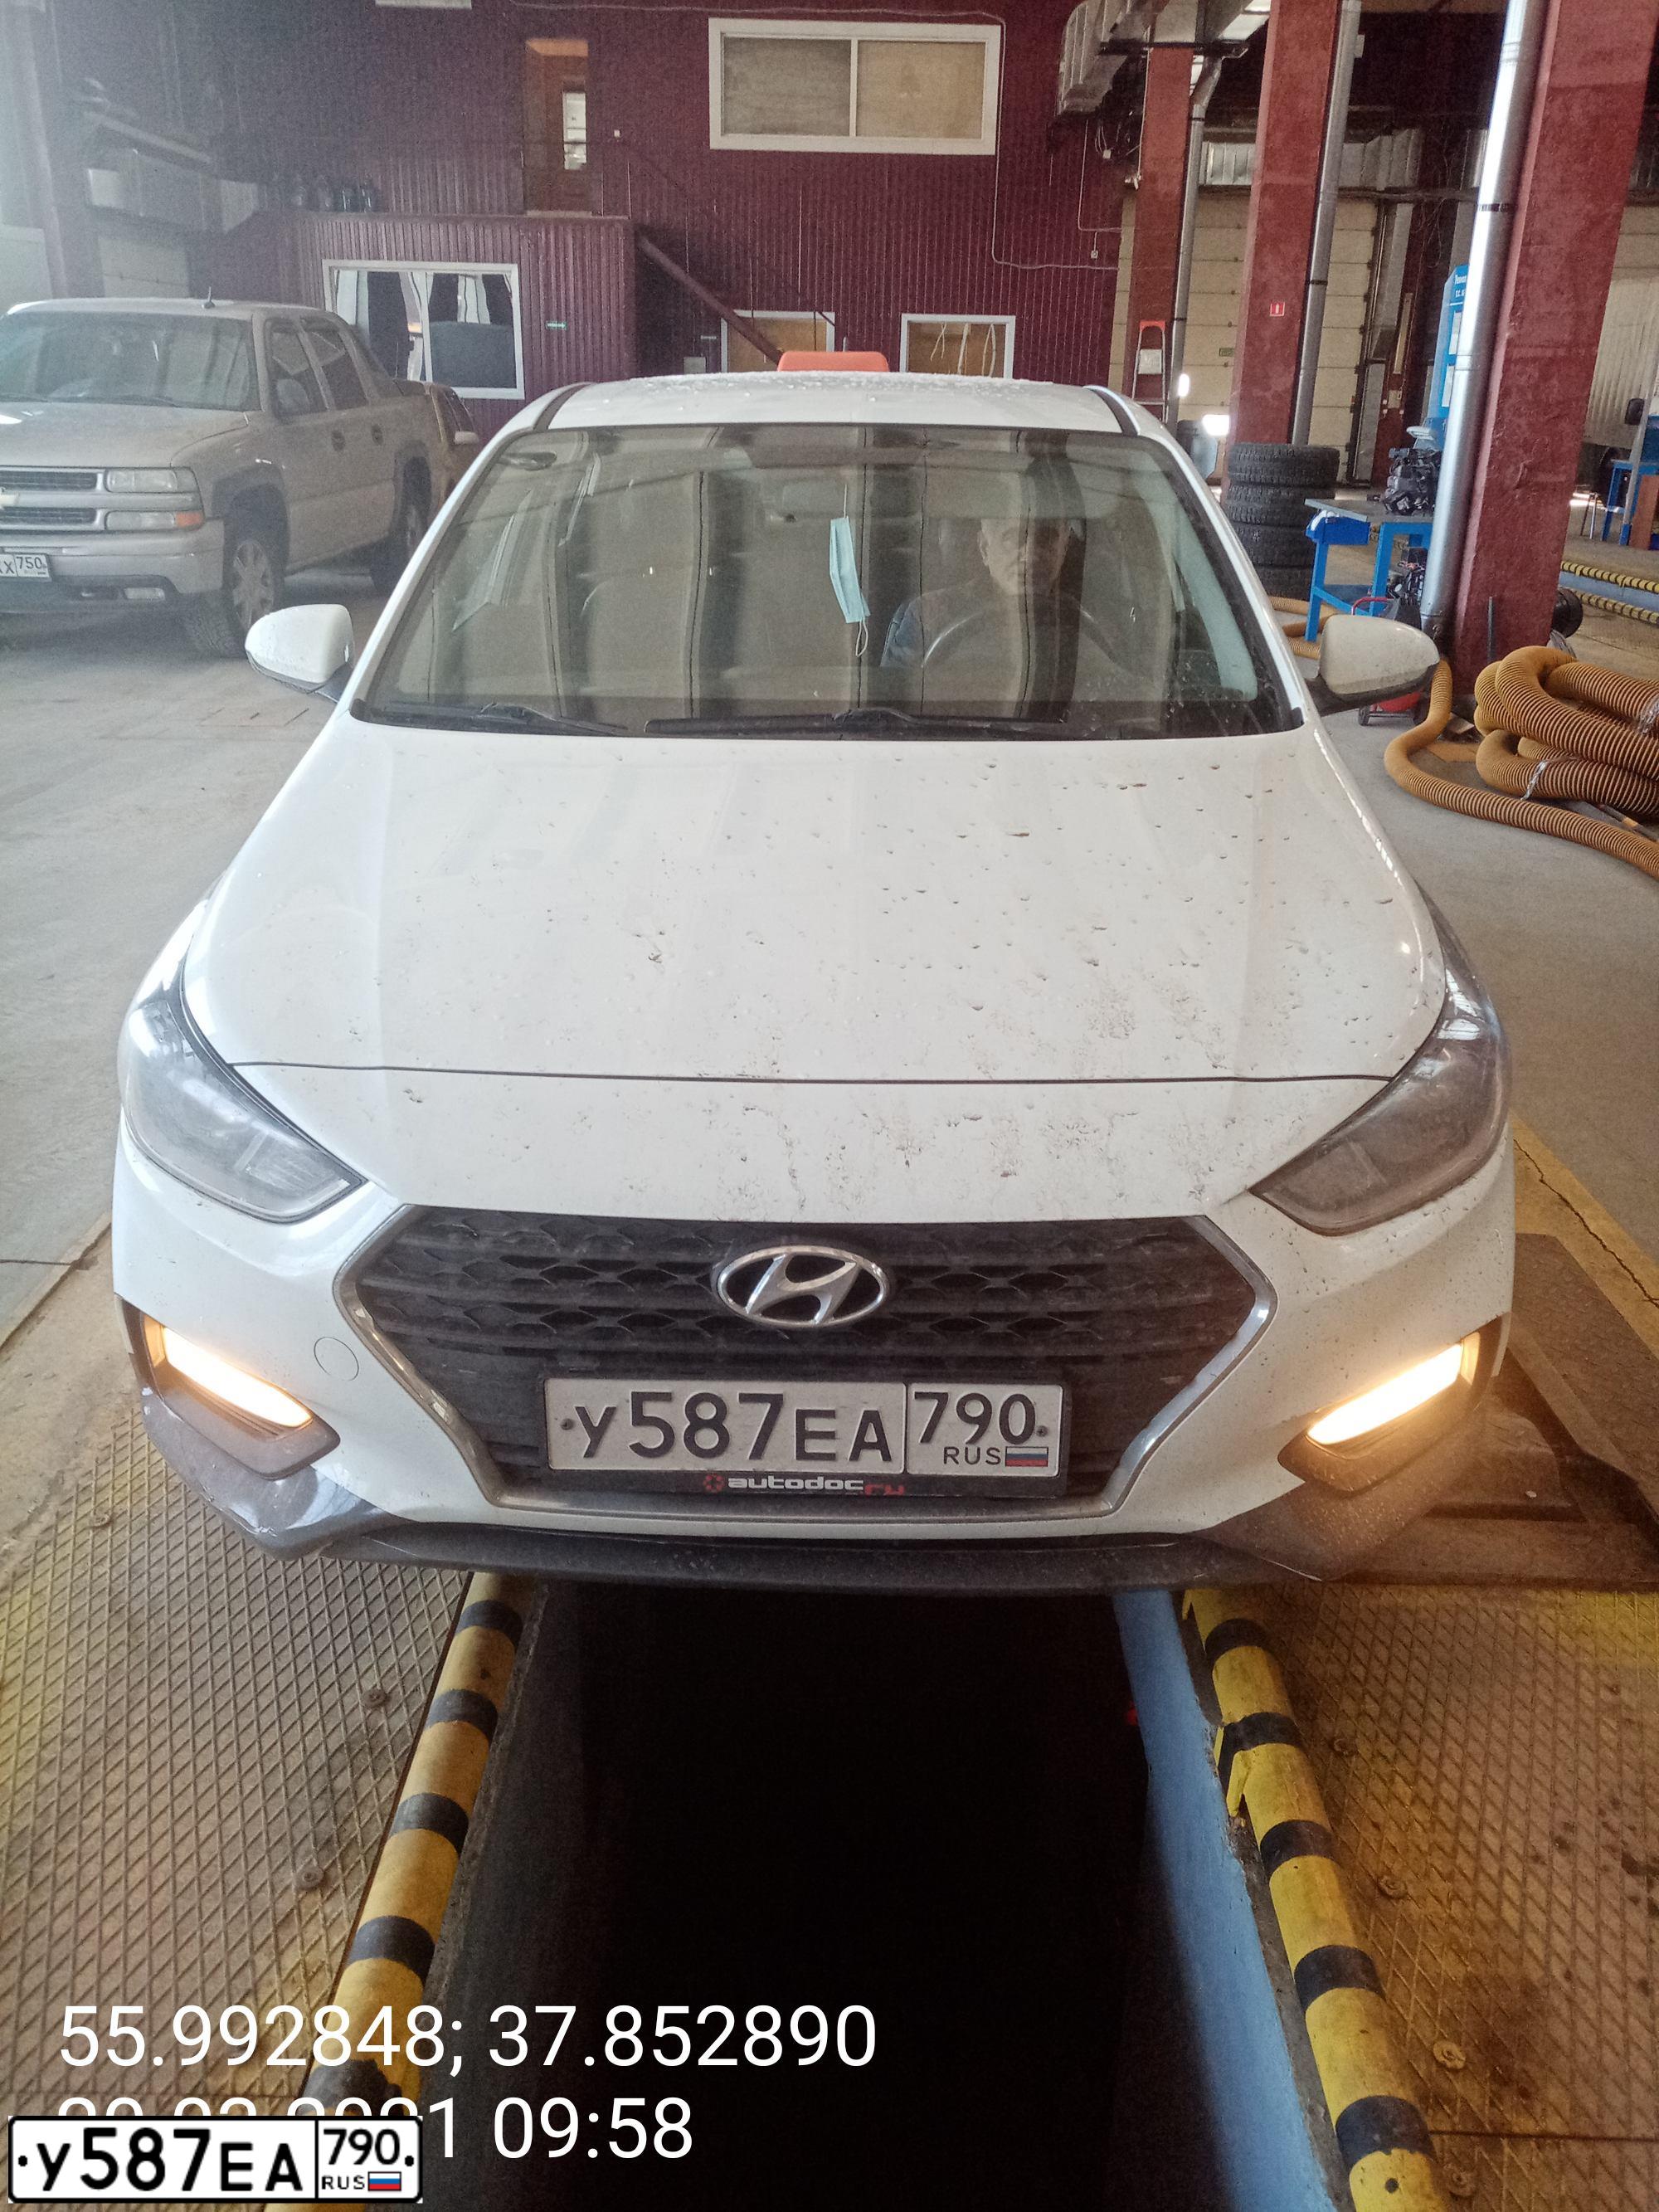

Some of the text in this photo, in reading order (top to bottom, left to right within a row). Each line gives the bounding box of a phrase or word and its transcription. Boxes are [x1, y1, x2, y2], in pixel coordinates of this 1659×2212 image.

[16, 556, 42, 569] 750
[574, 1391, 1036, 1462] У587ЕА 790
[943, 1446, 1002, 1465] RUS
